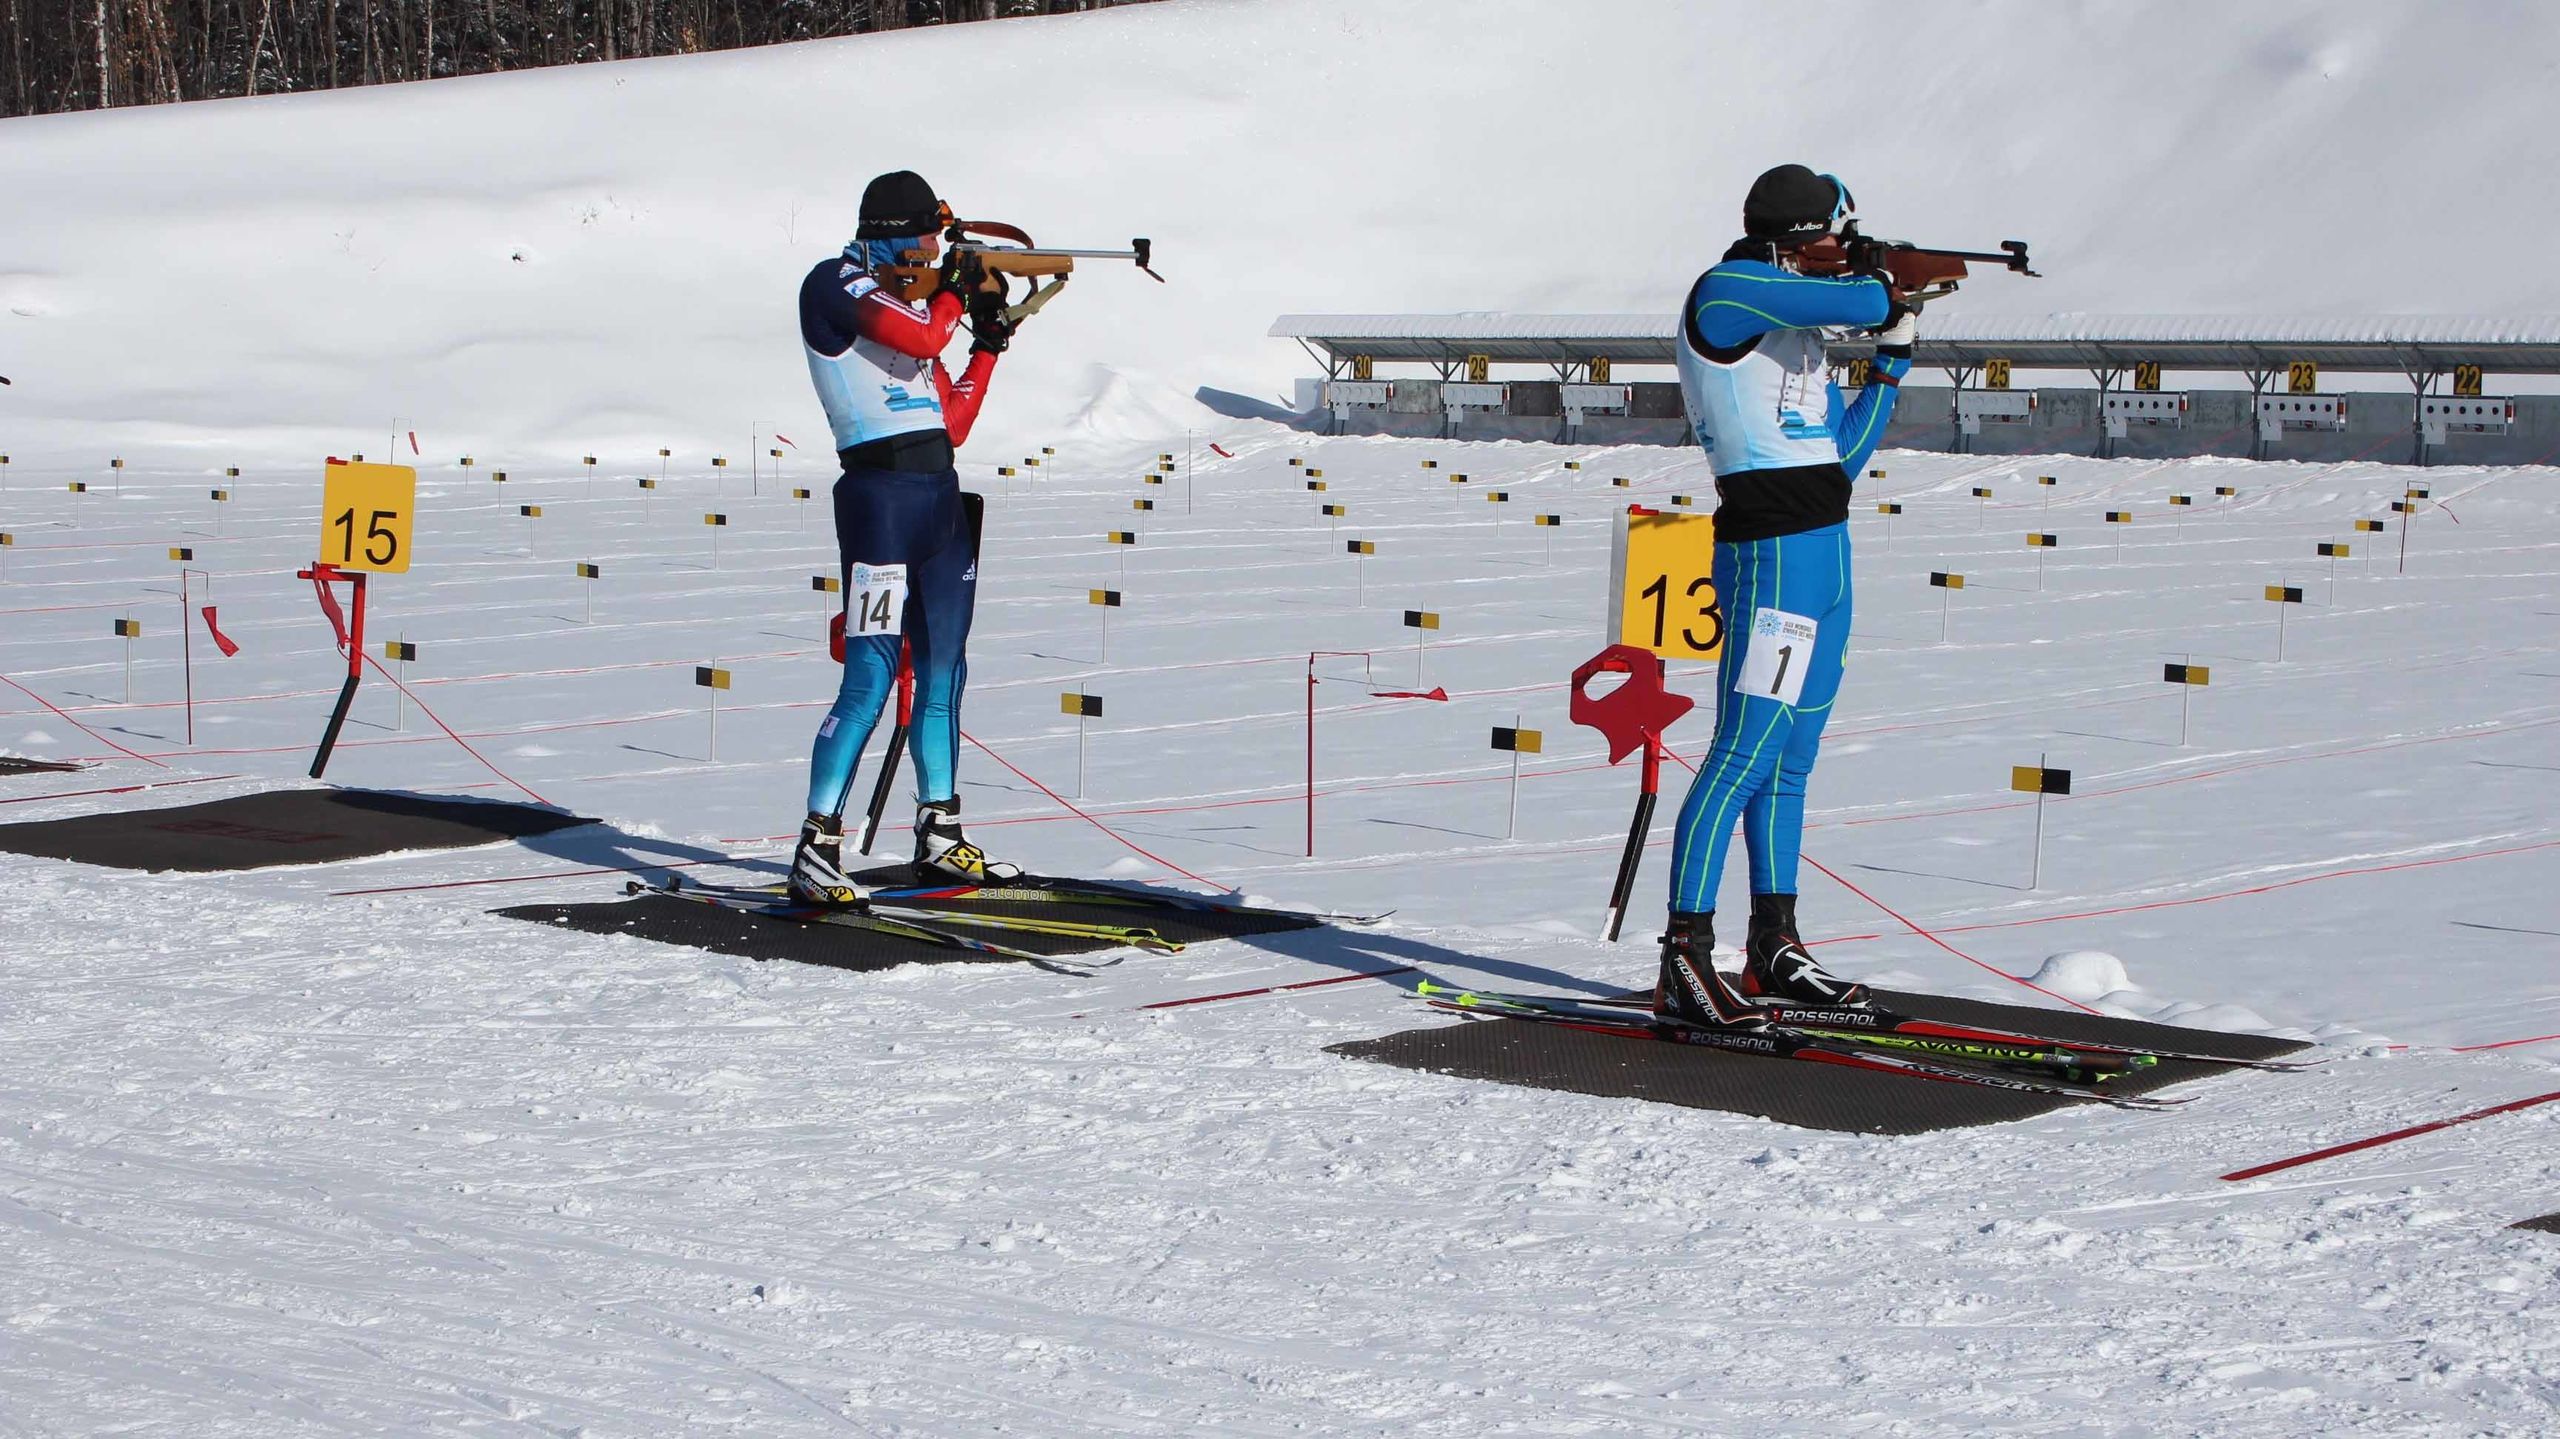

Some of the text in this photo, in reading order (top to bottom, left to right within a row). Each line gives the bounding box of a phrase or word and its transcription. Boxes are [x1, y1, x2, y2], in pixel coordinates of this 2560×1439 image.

[1788, 222, 1824, 232] Julbo
[1355, 355, 1371, 379] 30
[1470, 356, 1487, 380] 29
[1591, 357, 1609, 382] 28
[1989, 361, 2008, 388] 25
[2137, 362, 2158, 389] 24
[2291, 364, 2313, 391] 23
[2456, 366, 2480, 394] 22
[335, 507, 398, 566] 15
[859, 589, 891, 632] 14
[1641, 574, 1723, 651] 13
[1770, 645, 1792, 695] 1
[978, 887, 1050, 900] salomon
[1781, 1010, 1878, 1026] ROSSIGNOL
[1690, 1031, 1777, 1052] ROSSIGNOL
